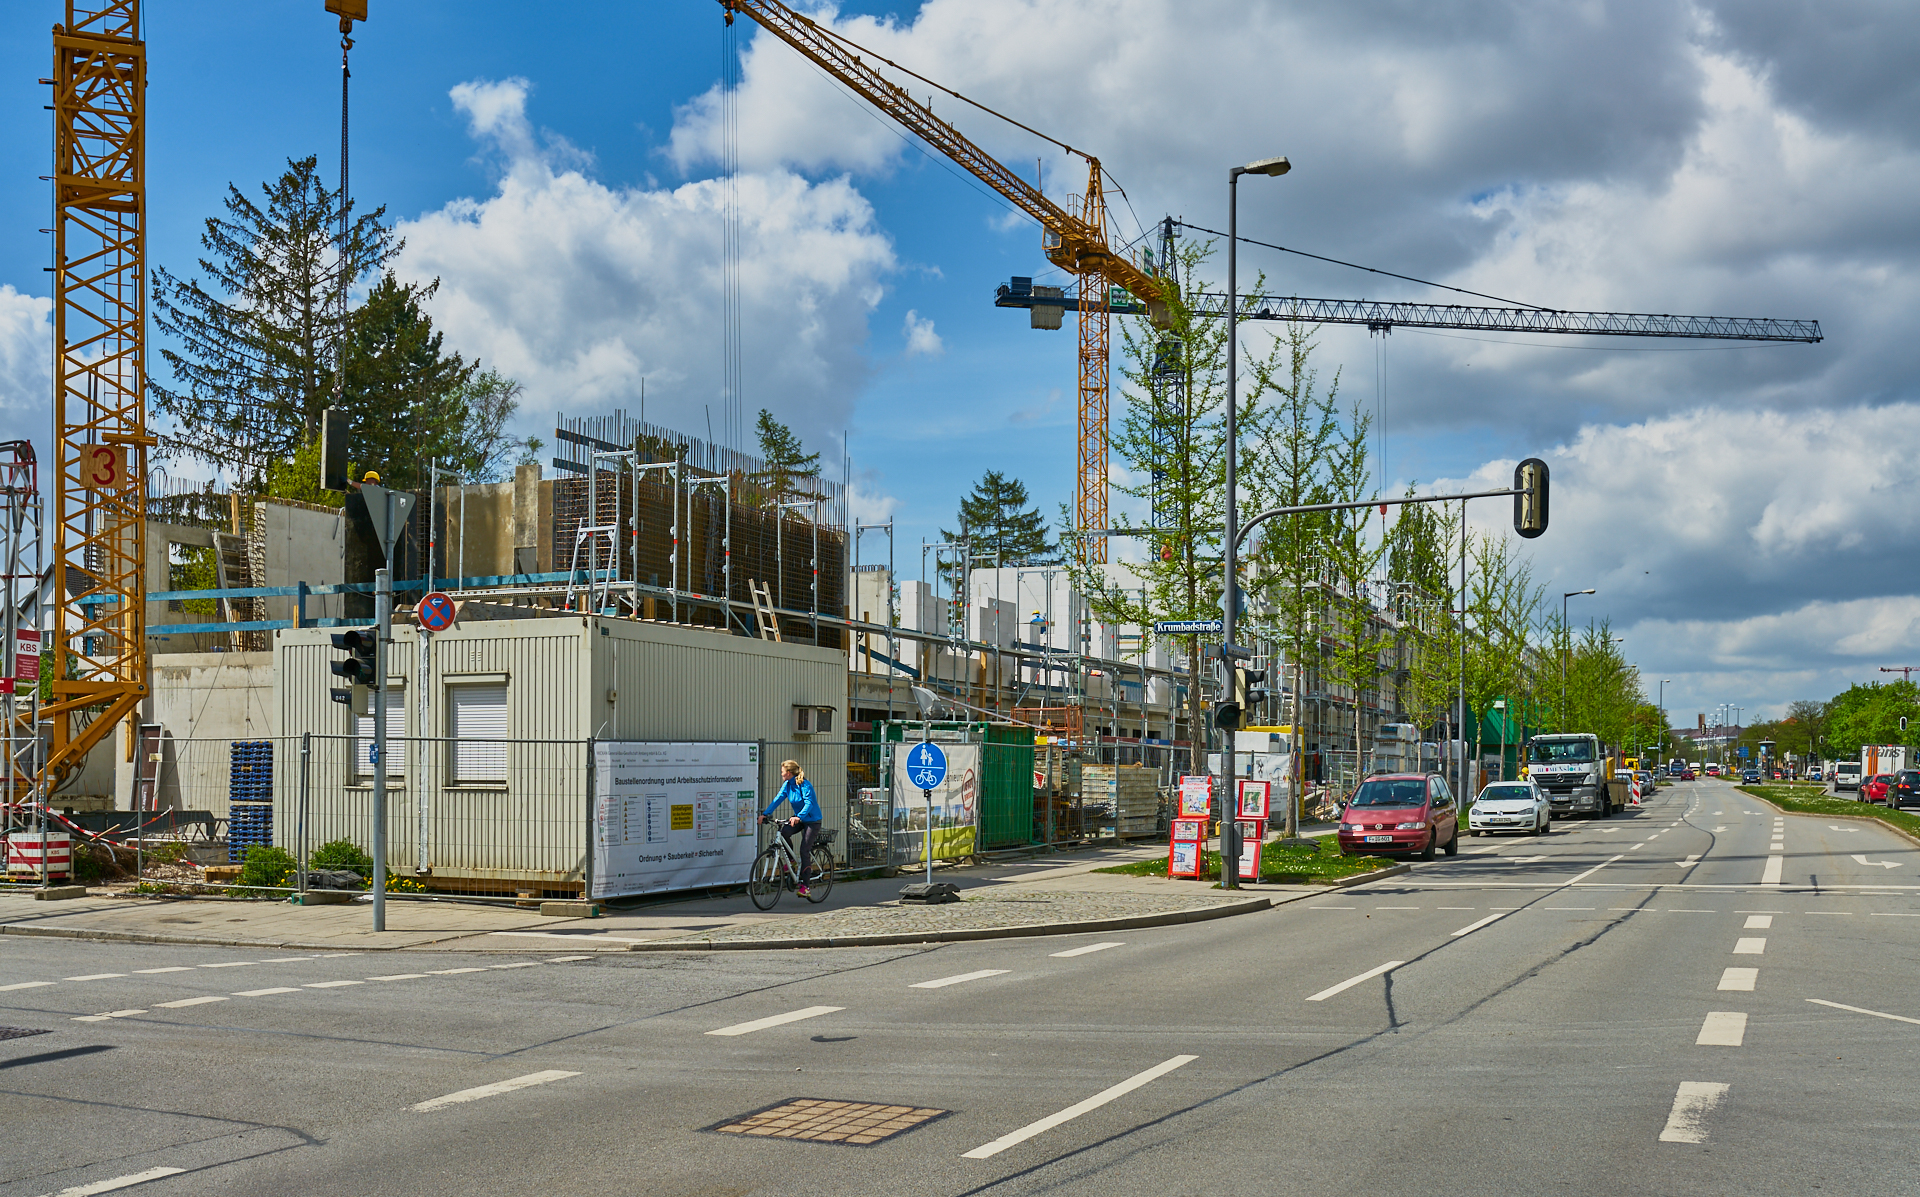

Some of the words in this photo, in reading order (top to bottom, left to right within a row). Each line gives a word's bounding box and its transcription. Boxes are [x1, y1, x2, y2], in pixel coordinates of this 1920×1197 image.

[92, 448, 116, 485] 3
[1157, 622, 1221, 632] Krumbadstraße
[20, 643, 37, 653] KBS
[614, 777, 665, 786] Baustellenordnung
[677, 775, 743, 784] Arbeitsschutzinformationen
[638, 854, 662, 863] Ordnung
[667, 851, 694, 861] Sauberkeit
[698, 849, 724, 858] Sicherheit
